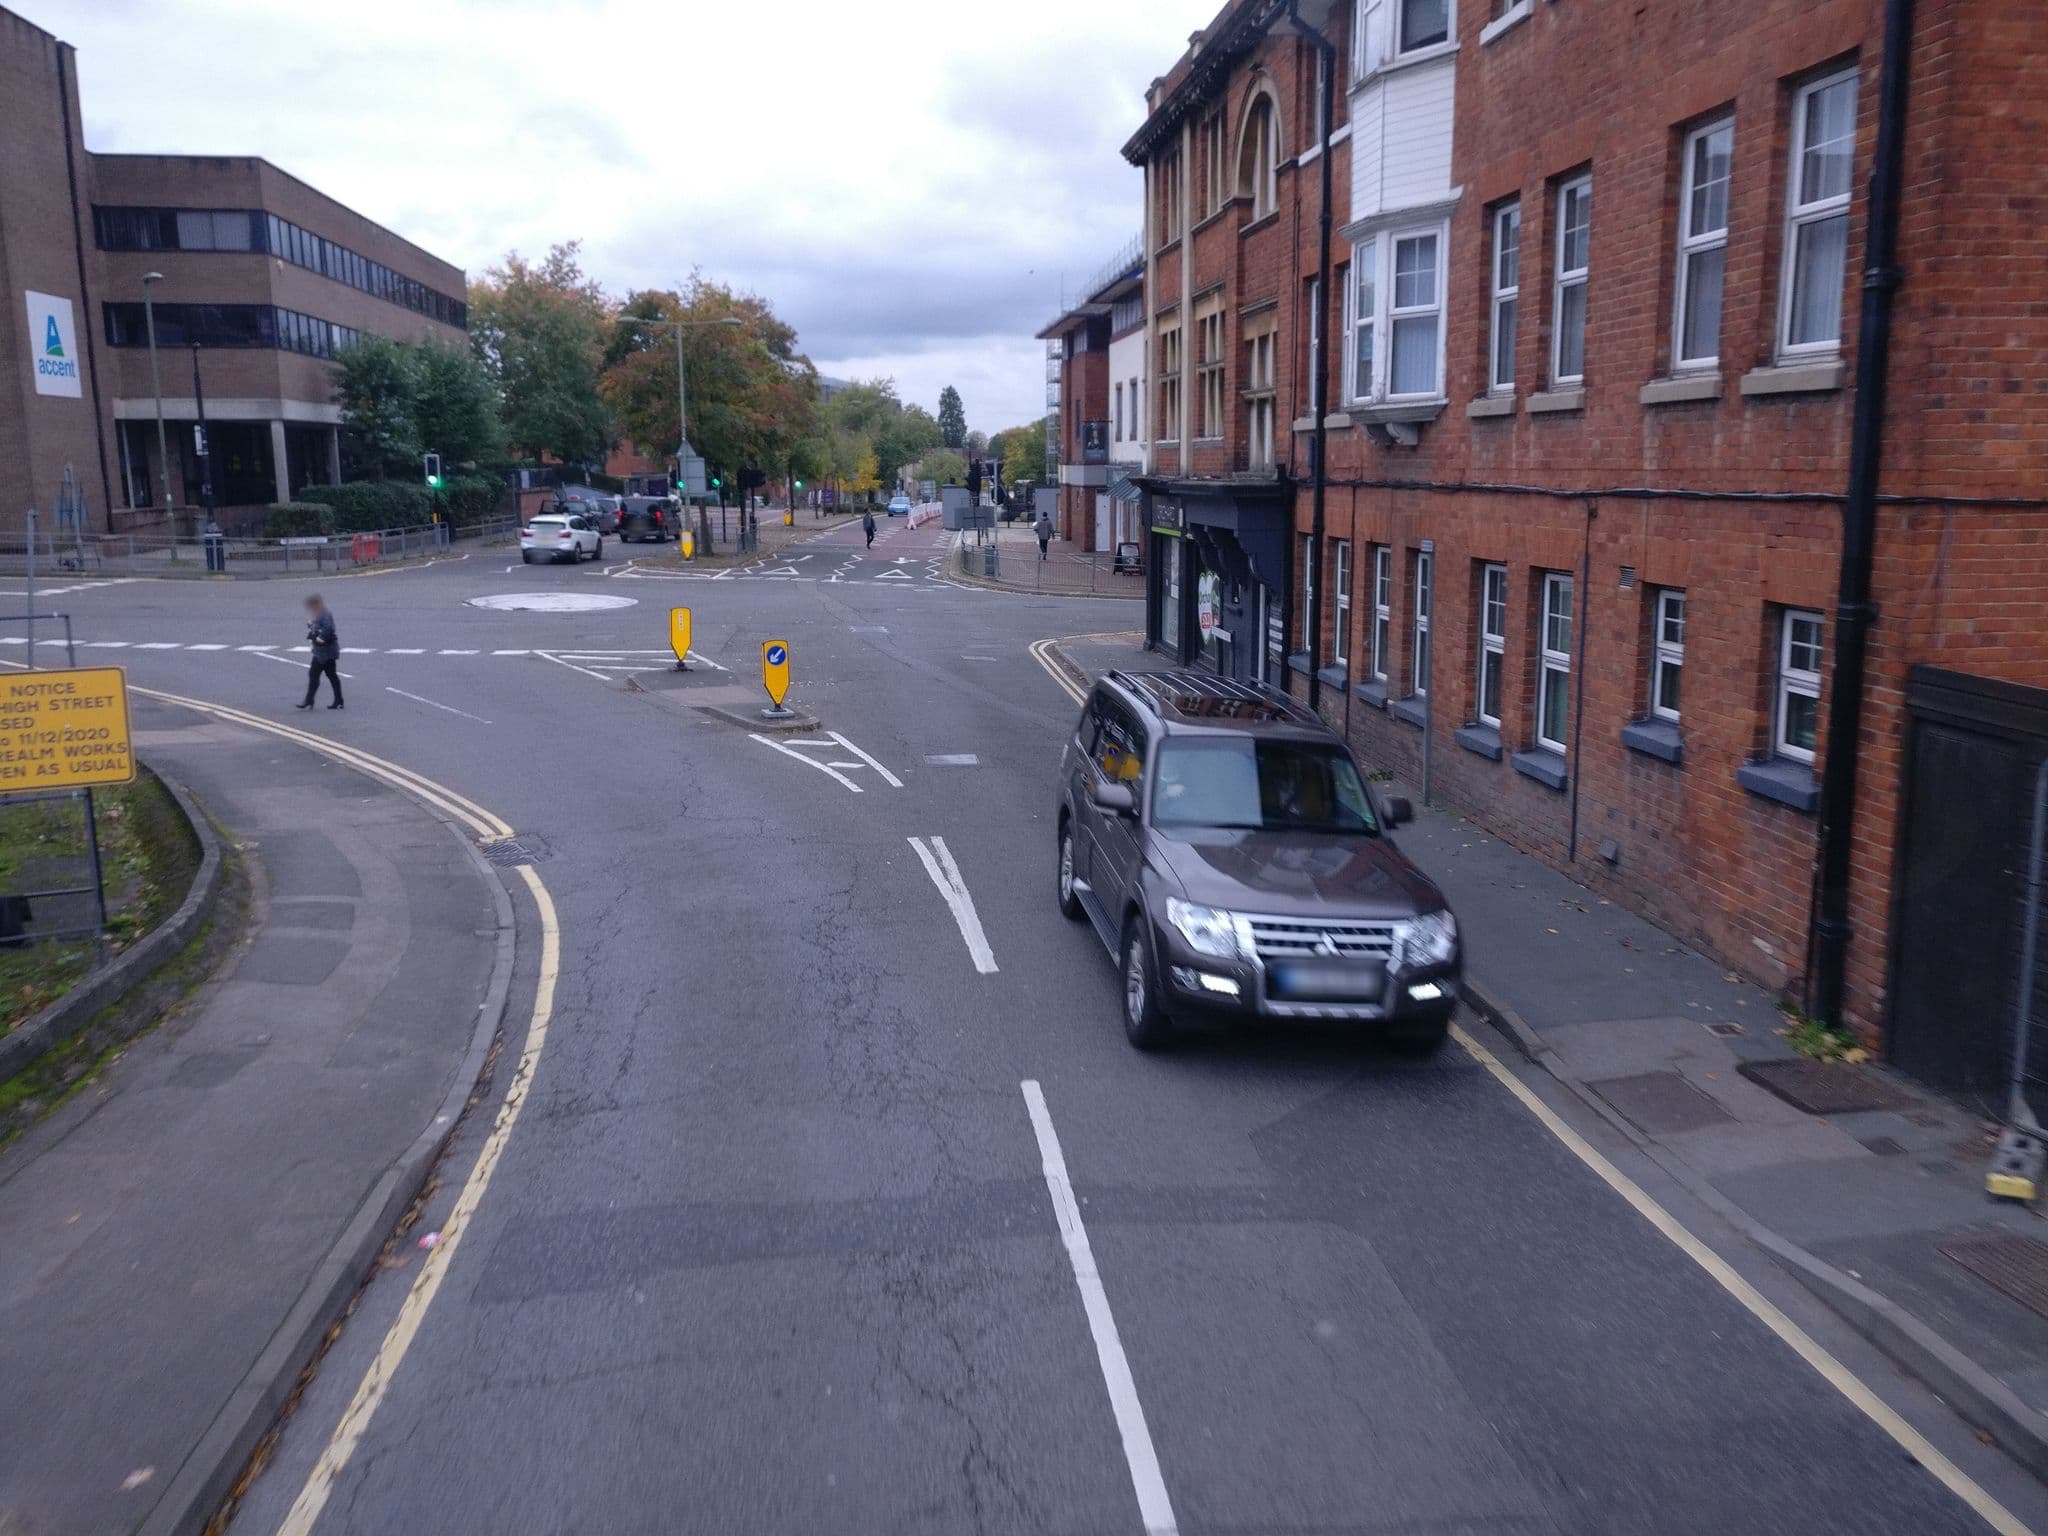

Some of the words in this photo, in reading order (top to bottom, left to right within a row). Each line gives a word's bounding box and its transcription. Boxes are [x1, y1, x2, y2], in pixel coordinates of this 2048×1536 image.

[39, 359, 76, 378] accent
[10, 682, 76, 697] NOTICE
[49, 695, 115, 711] STREET
[19, 727, 110, 745] 11/12/2020
[63, 742, 128, 757] WORKS
[0, 764, 26, 778] EN
[36, 762, 60, 776] AS
[70, 757, 127, 773] USUAL
